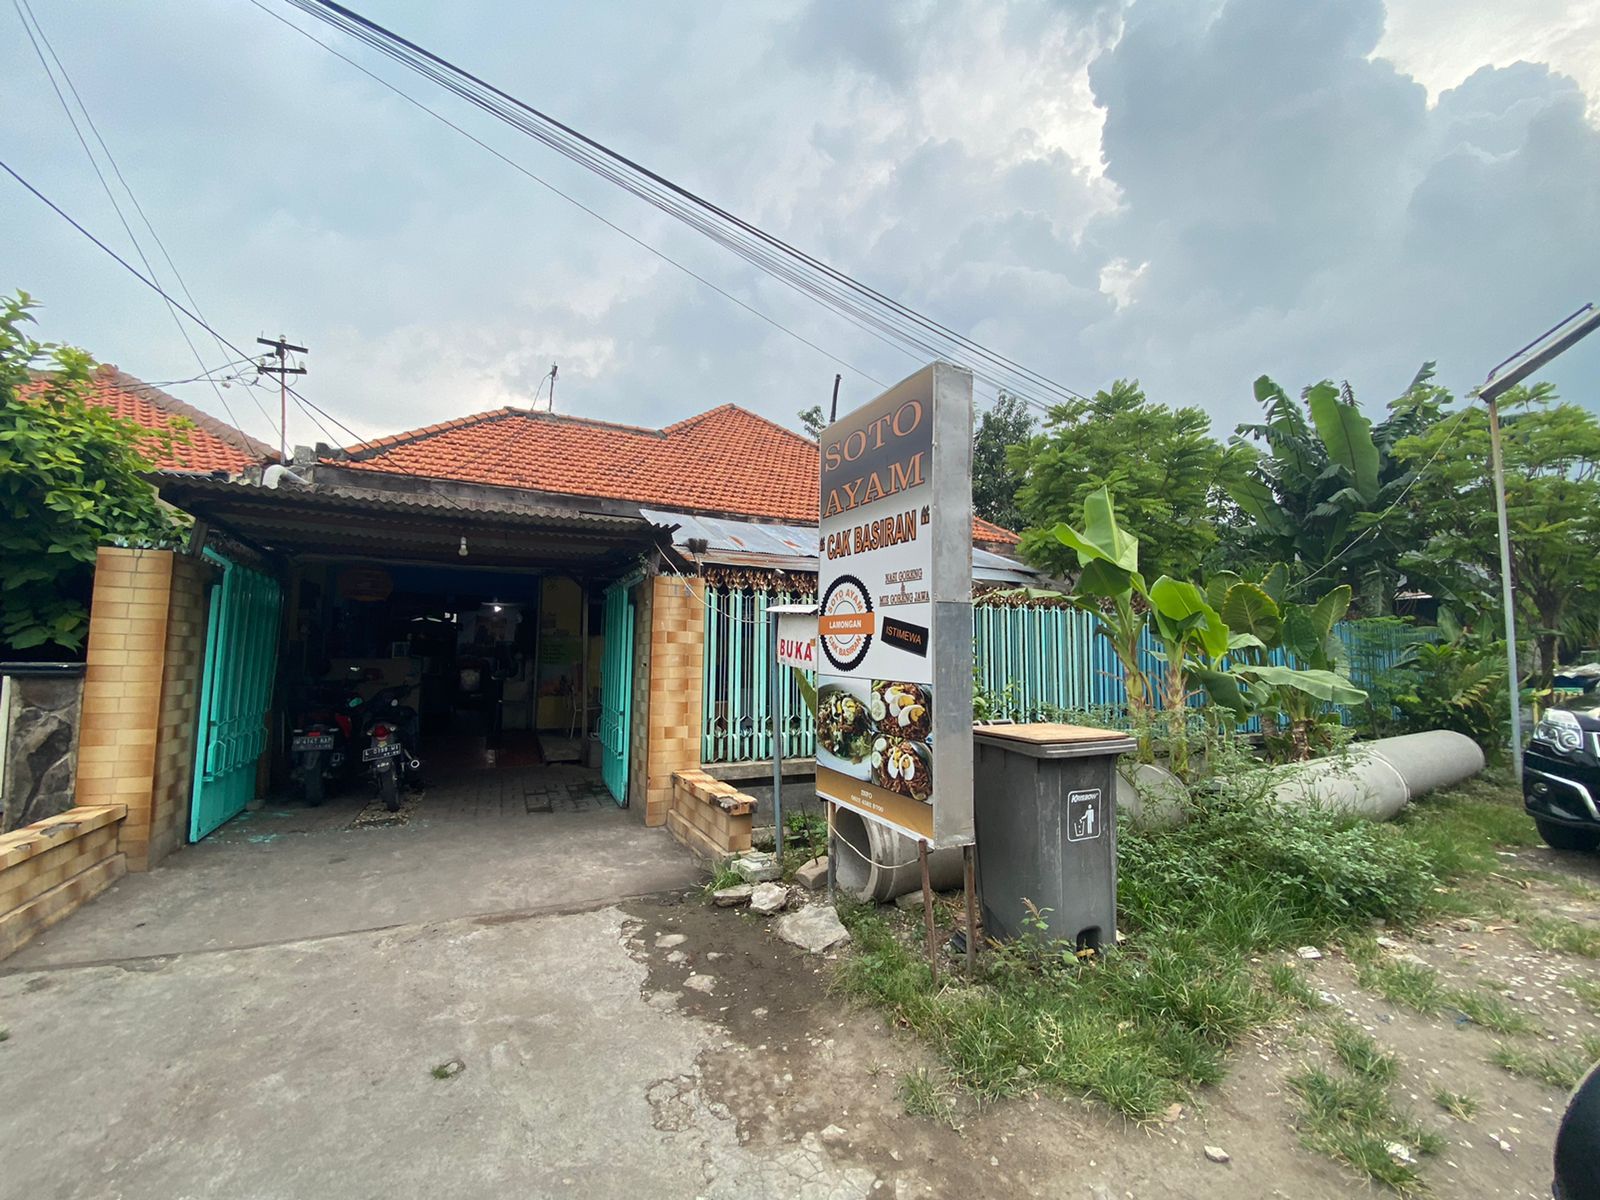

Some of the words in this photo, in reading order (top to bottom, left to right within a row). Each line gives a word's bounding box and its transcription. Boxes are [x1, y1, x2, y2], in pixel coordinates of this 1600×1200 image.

[825, 400, 922, 472] SOTO
[823, 452, 925, 519] AYAM
[827, 529, 851, 560] CAK
[854, 510, 917, 554] BASIRAN
[828, 590, 844, 613] SOTO
[845, 589, 863, 611] AYAM
[829, 619, 862, 629] LAMONGAN
[885, 625, 922, 645] ISTIMEWA
[780, 639, 812, 661] BUKA
[828, 636, 838, 653] CAK
[838, 635, 862, 656] BASIRAN
